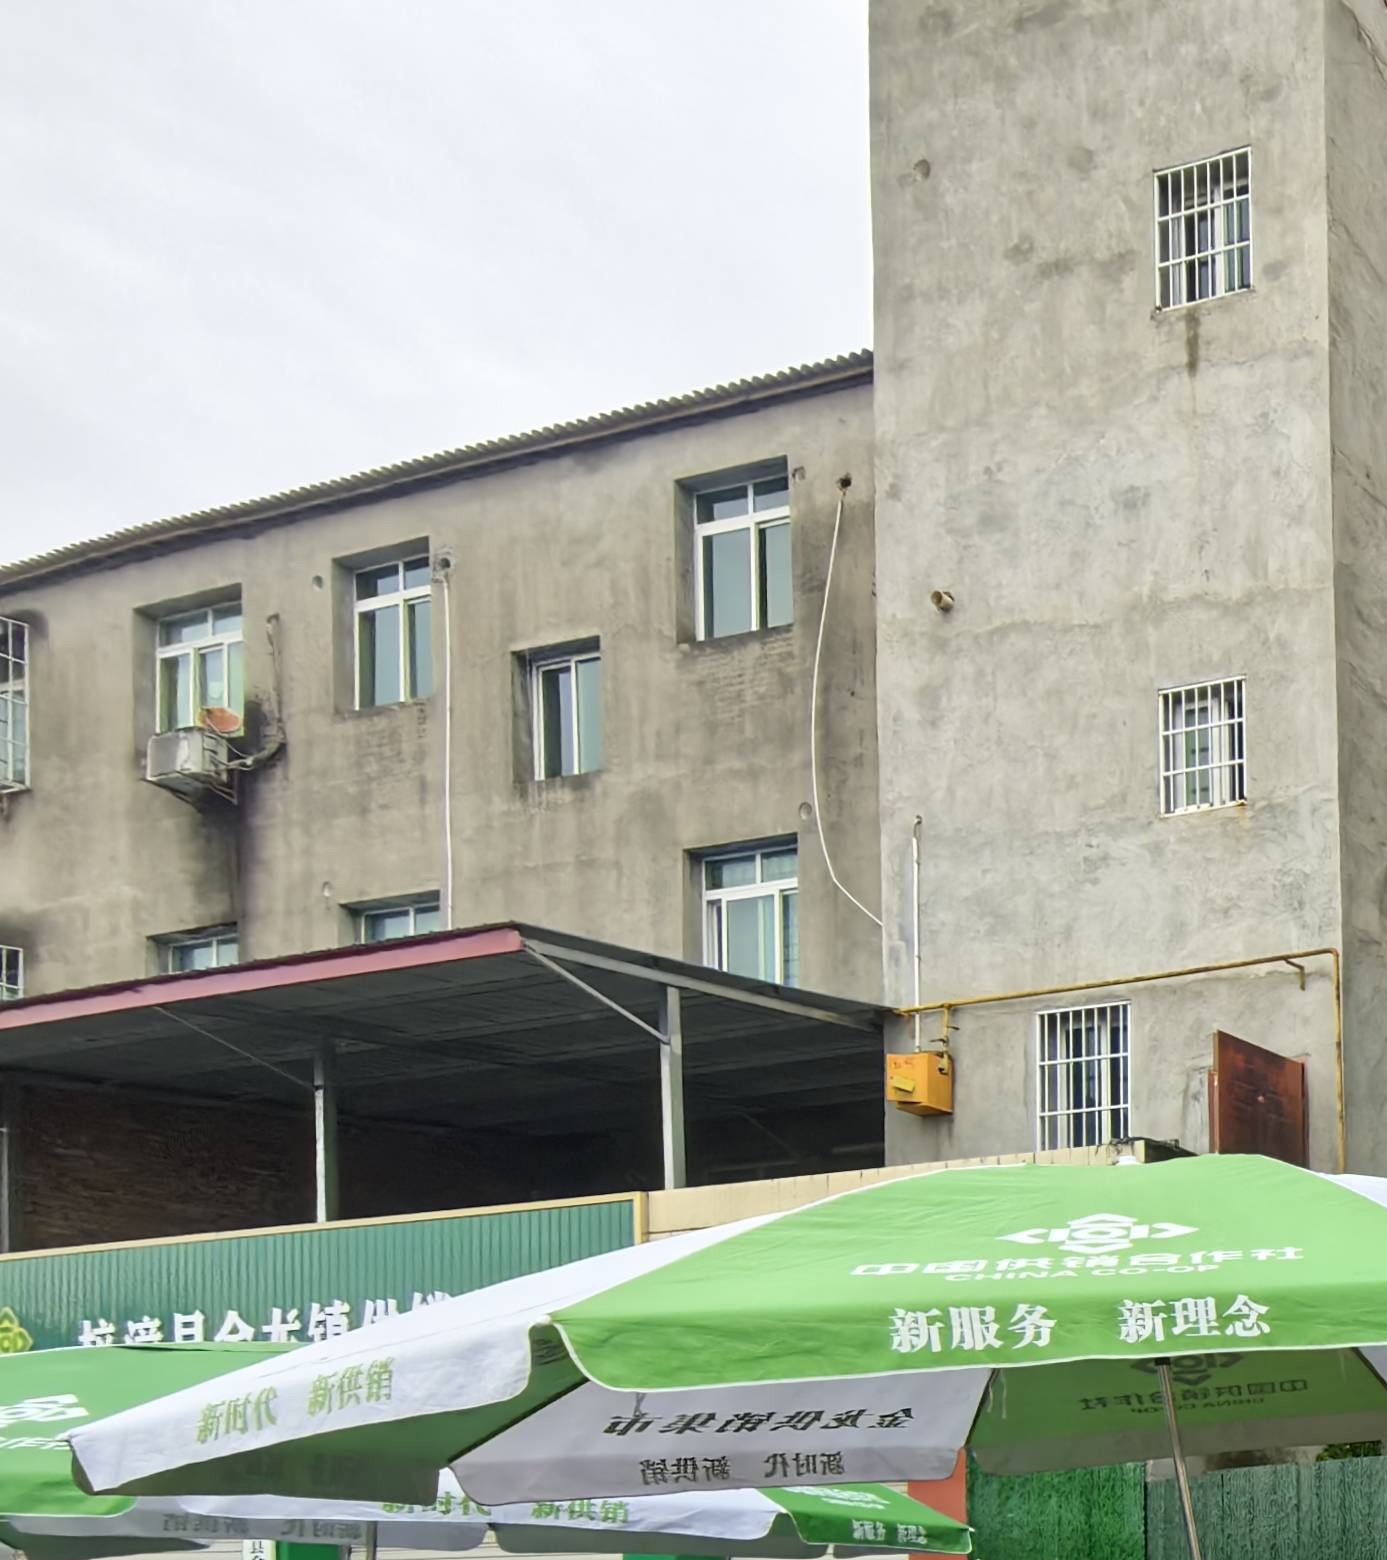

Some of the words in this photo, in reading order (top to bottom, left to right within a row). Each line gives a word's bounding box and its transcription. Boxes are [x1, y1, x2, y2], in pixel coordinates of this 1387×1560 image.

[850, 1246, 1304, 1276] 中国供销合作社
[944, 1268, 1080, 1281] CHINA
[1090, 1264, 1221, 1278] CO-OP
[889, 1303, 1058, 1353] 新服务
[1118, 1294, 1271, 1343] 新理念
[196, 1386, 278, 1443] 新时代
[306, 1357, 396, 1416] 新供销
